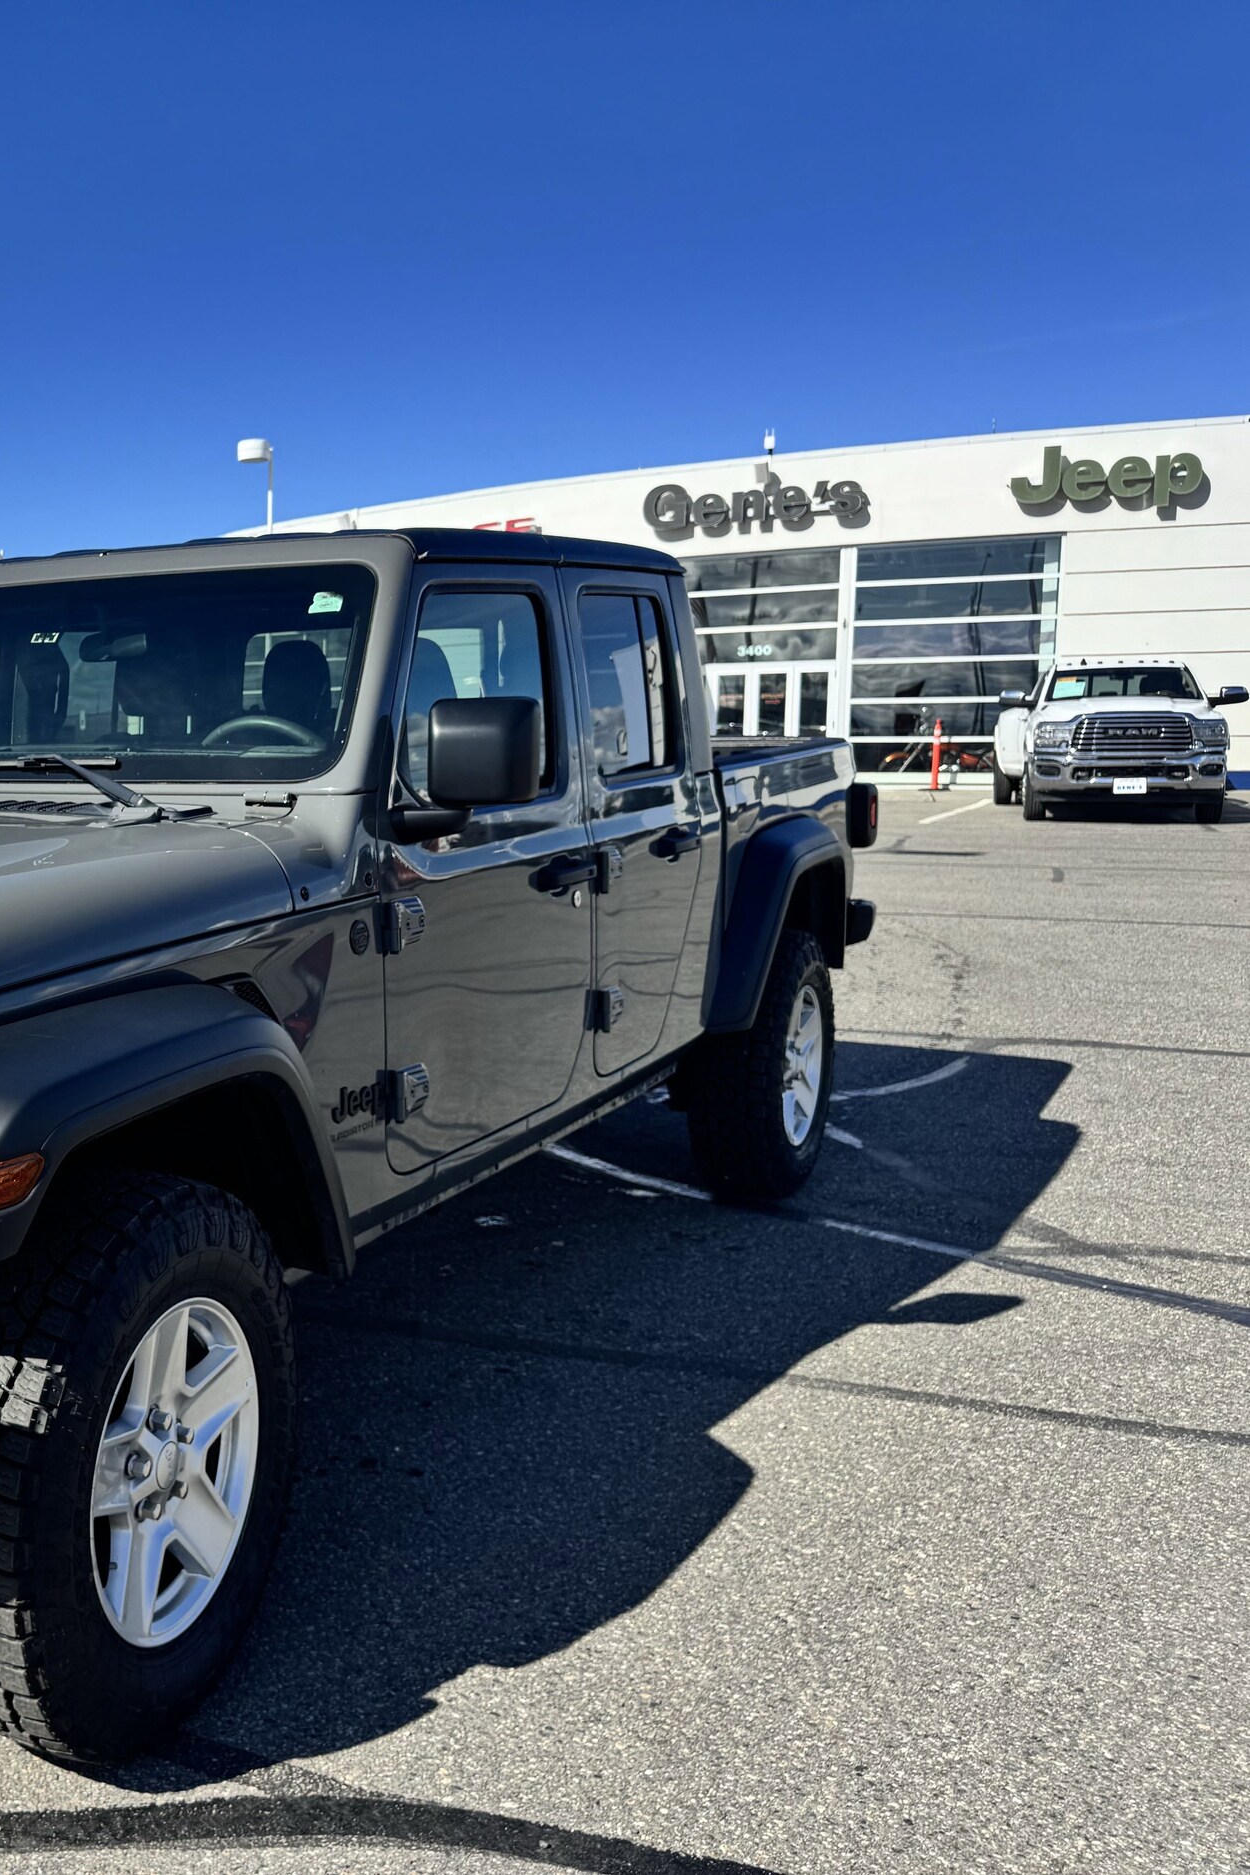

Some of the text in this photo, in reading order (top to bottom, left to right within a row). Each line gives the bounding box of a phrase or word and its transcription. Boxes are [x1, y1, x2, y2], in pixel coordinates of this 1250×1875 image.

[1010, 446, 1203, 507] Jeep
[643, 480, 864, 529] Gene's
[736, 644, 772, 657] 3400
